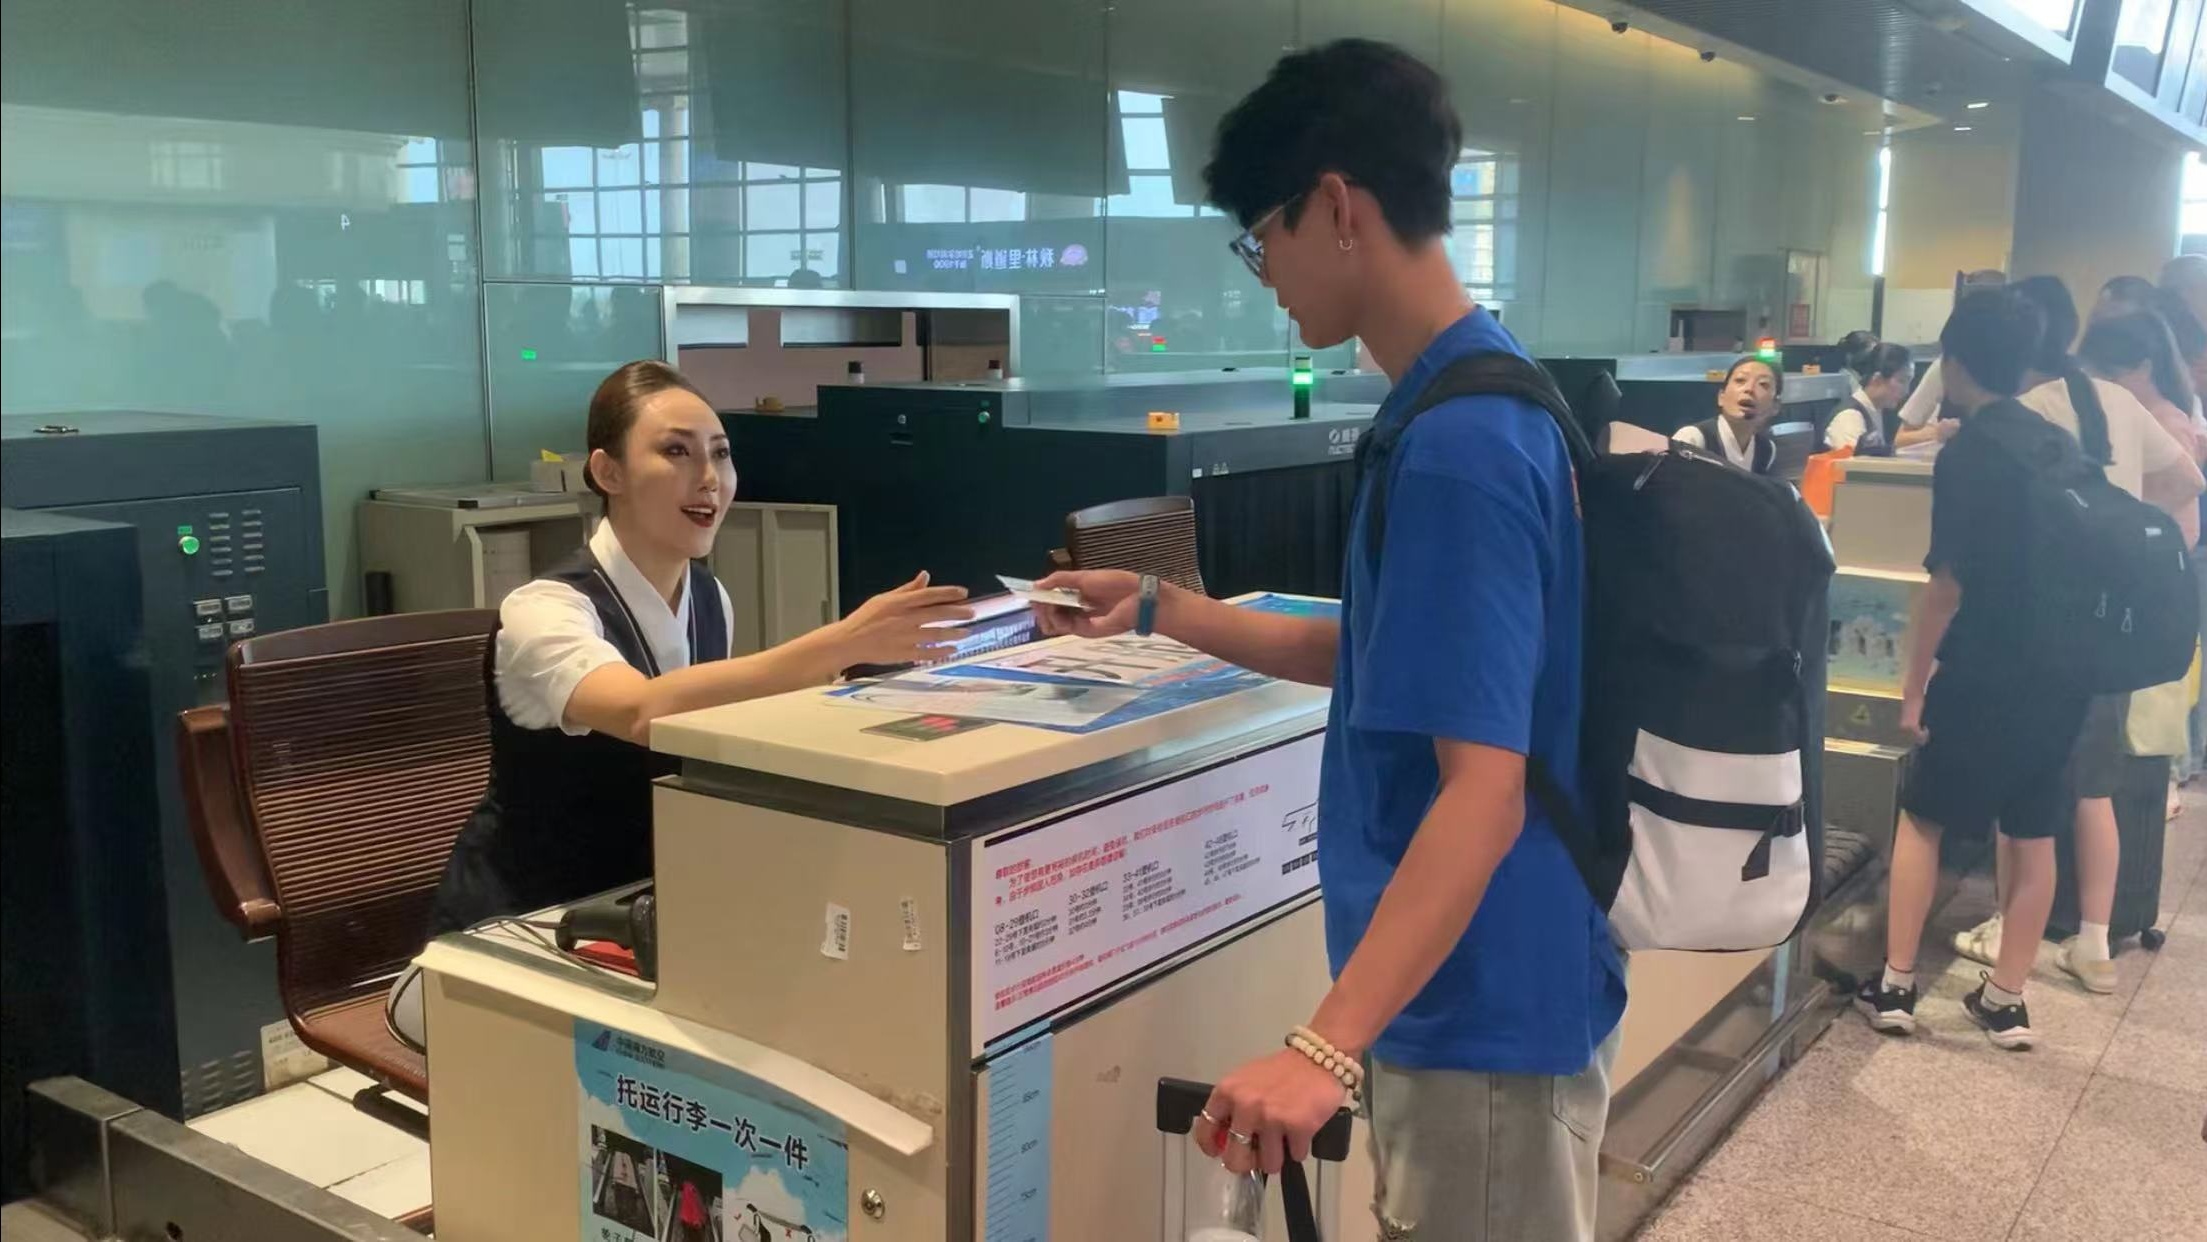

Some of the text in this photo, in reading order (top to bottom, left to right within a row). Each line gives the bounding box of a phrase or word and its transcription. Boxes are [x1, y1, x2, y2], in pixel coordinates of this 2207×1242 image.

[616, 1073, 809, 1170] 托运行李一次一件
